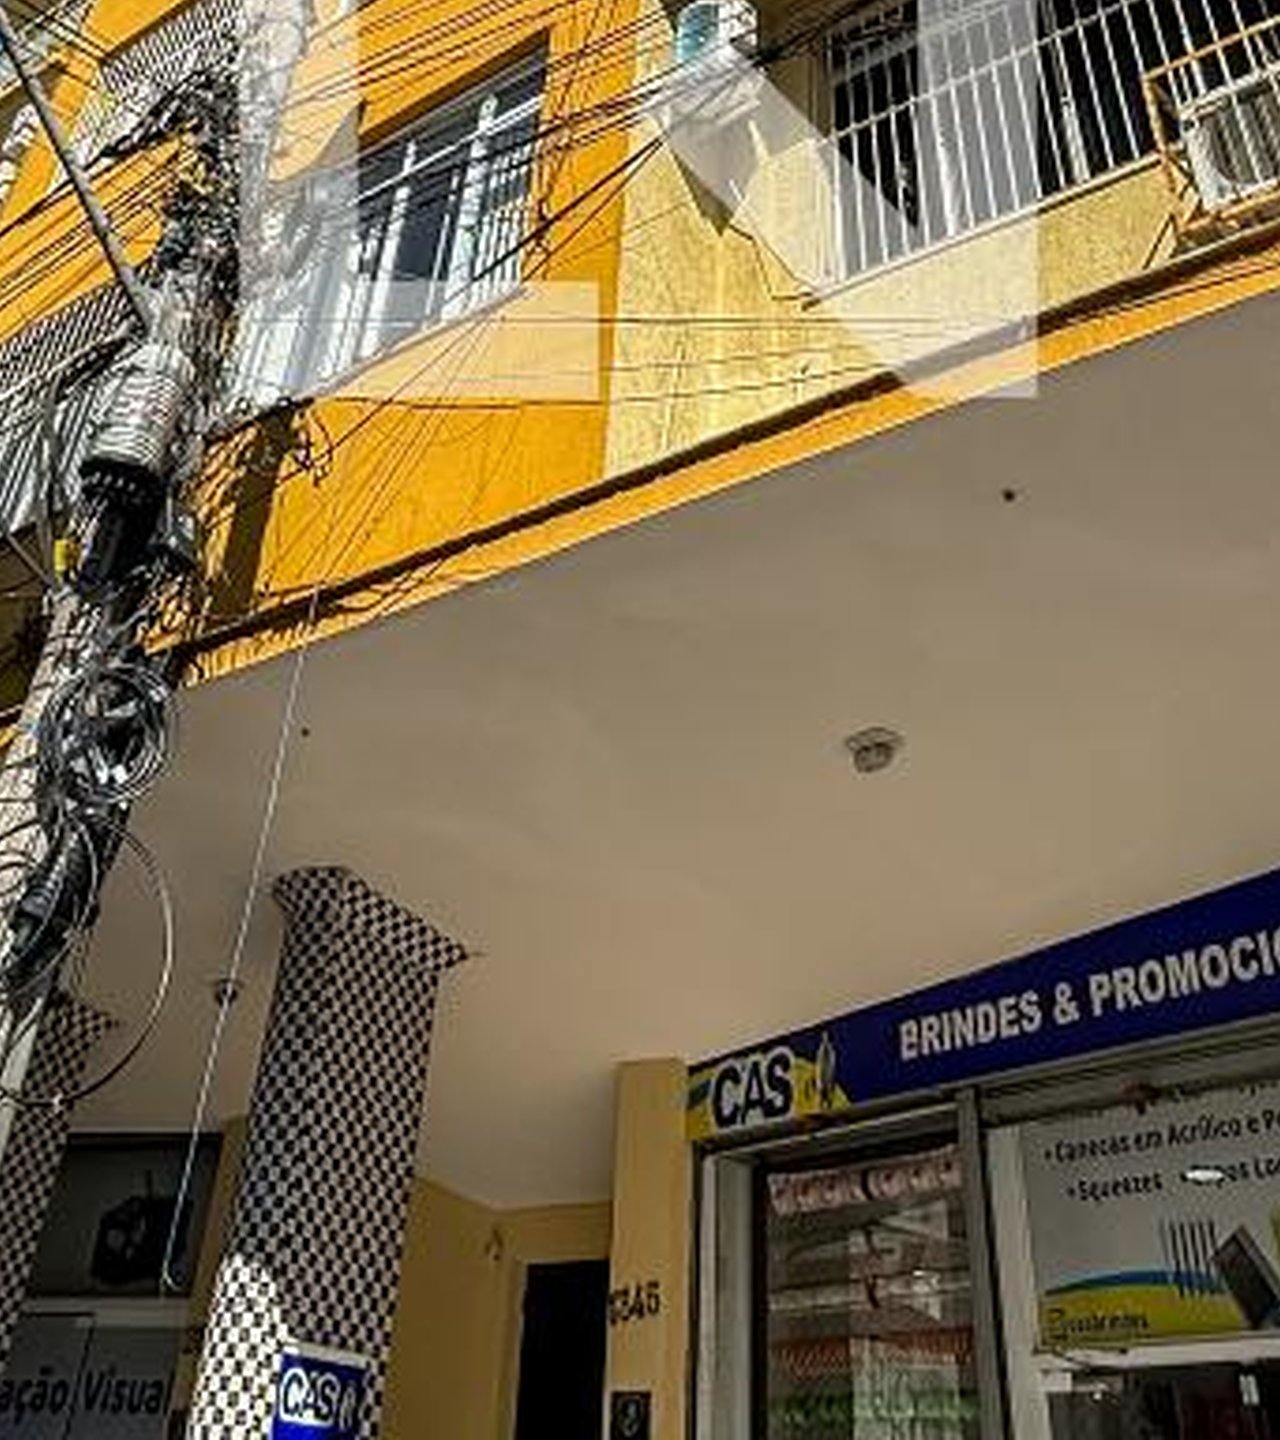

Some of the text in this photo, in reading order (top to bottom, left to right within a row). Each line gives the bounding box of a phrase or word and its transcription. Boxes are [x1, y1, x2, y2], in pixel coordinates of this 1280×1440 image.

[898, 991, 1041, 1061] BRINDES
[1053, 977, 1081, 1029] &
[1055, 1133, 1131, 1163] Canecas
[1134, 1131, 1163, 1153] em
[1246, 1116, 1259, 1134] e
[1078, 1172, 1162, 1203] Squeezes
